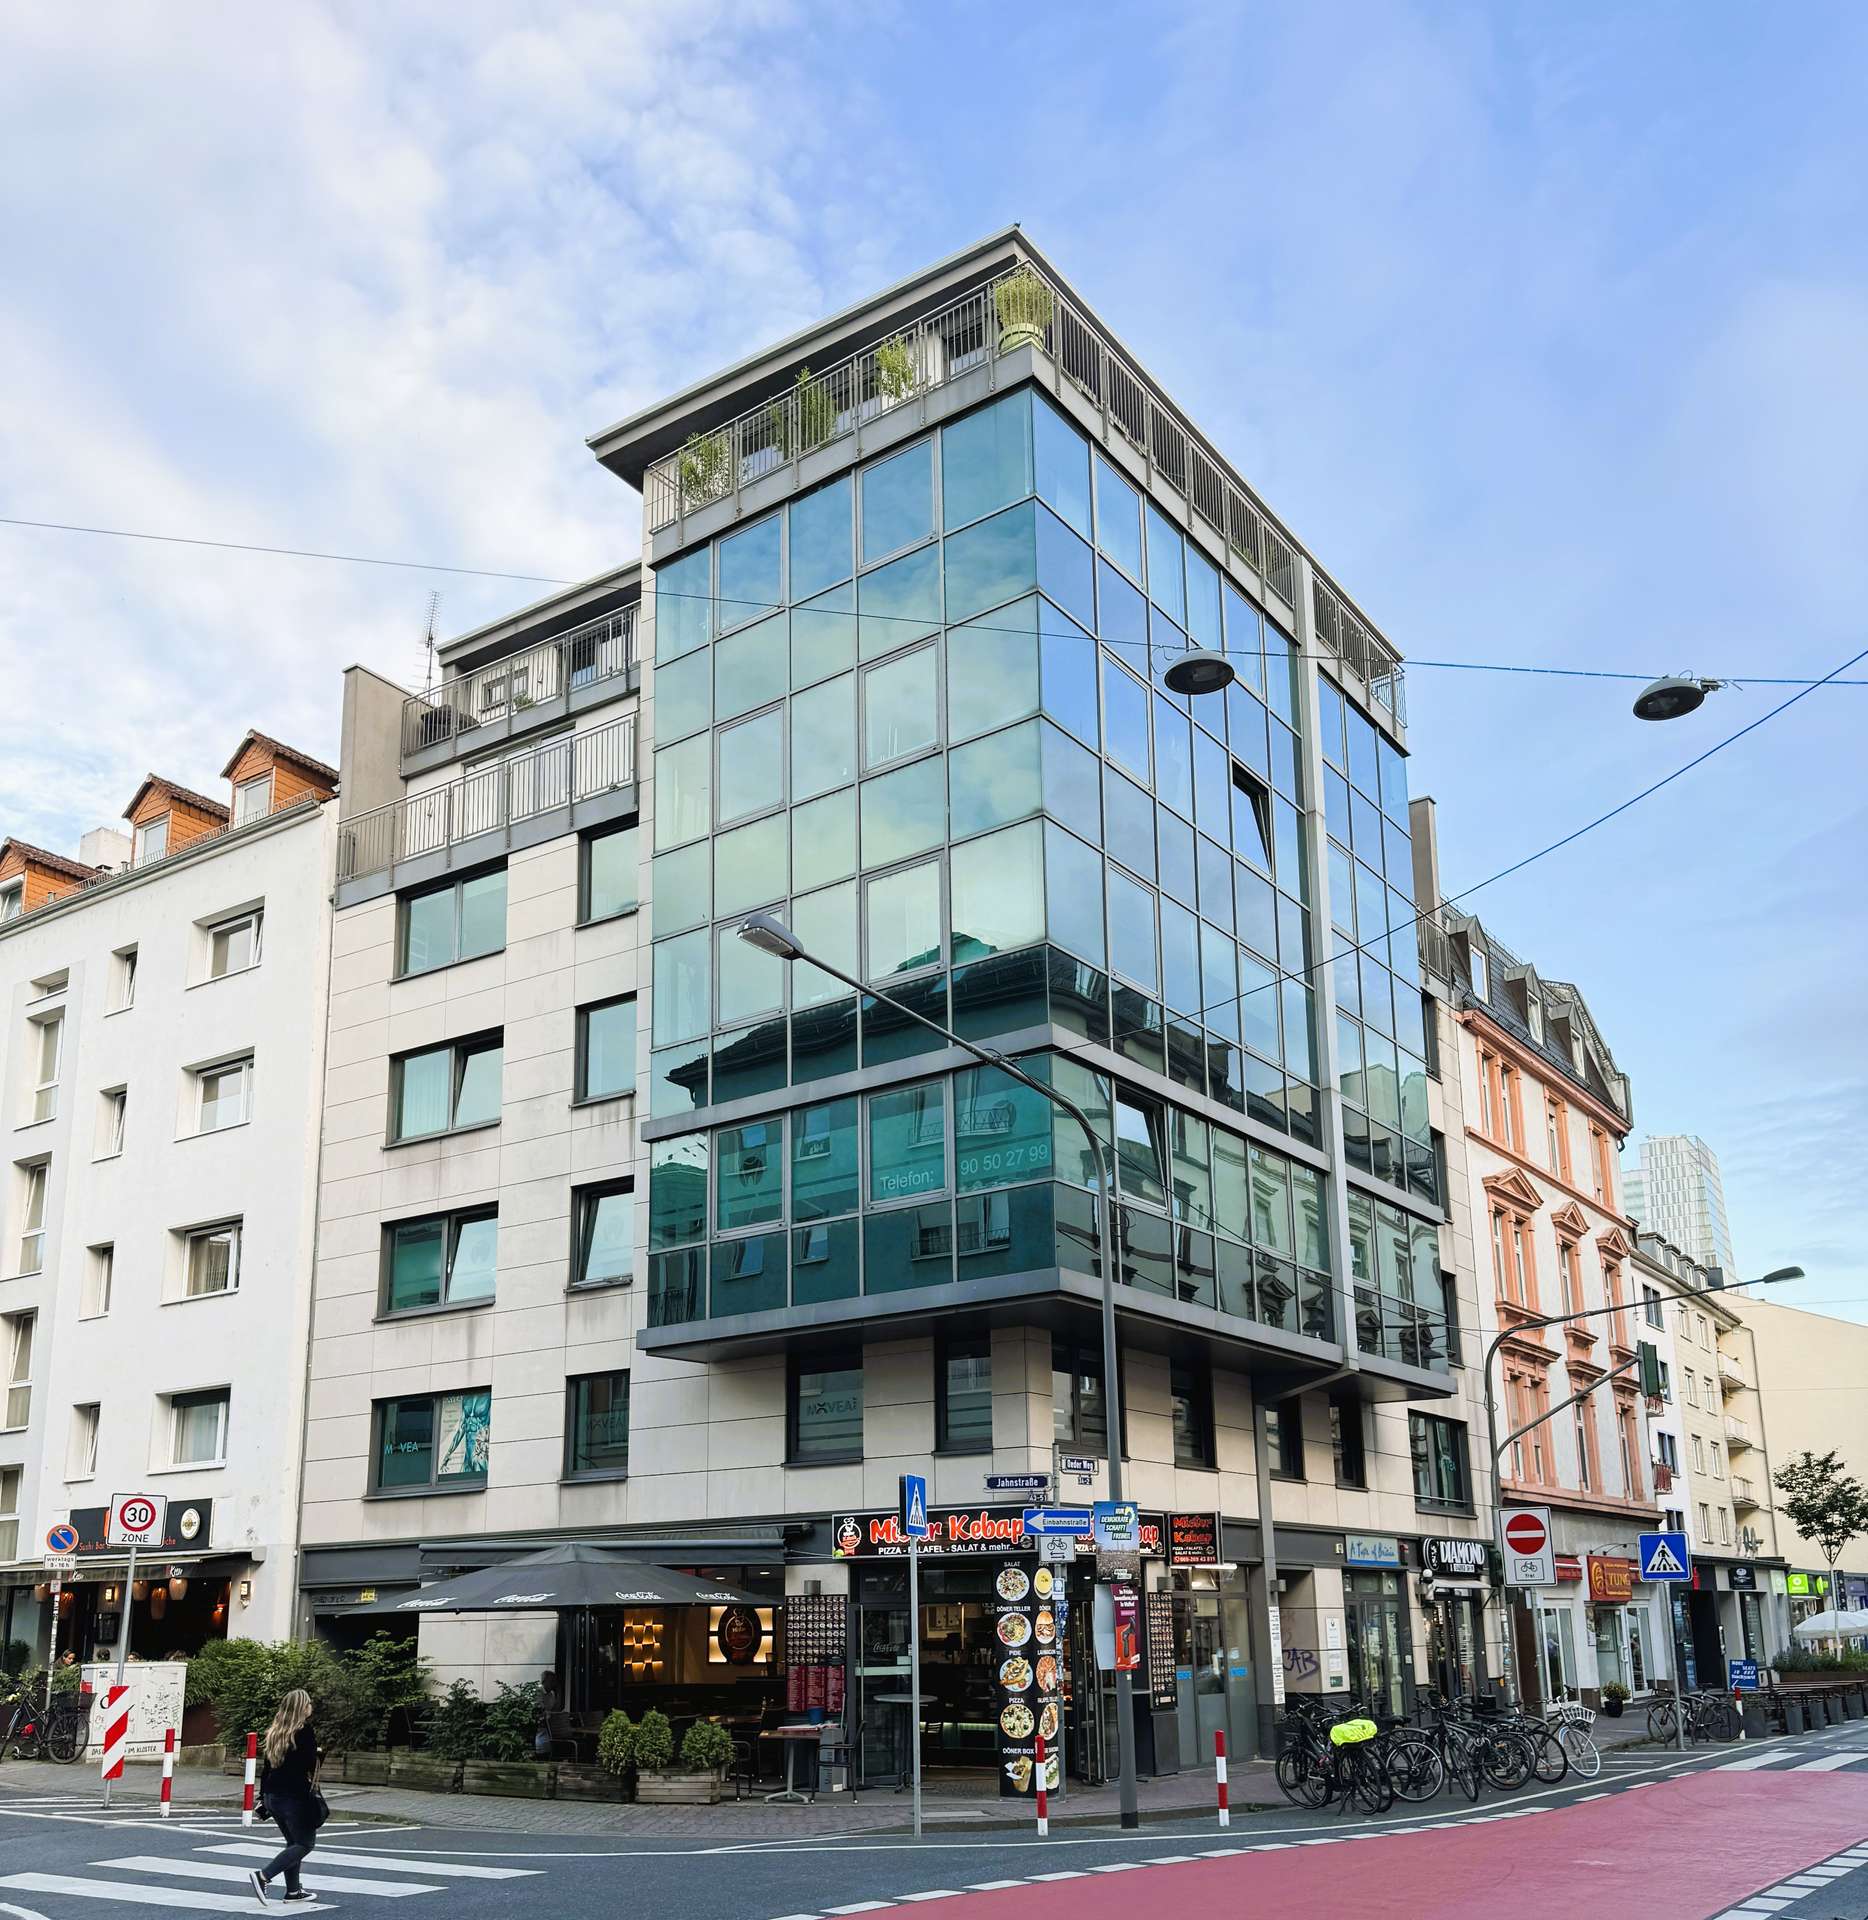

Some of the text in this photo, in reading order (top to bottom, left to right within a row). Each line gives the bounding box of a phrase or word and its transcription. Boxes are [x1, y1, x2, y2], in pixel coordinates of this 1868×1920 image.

[879, 1143, 1048, 1191] Telefon: 90 50 27 99
[1084, 1459, 1094, 1471] Weg
[996, 1478, 1039, 1488] Jahnstraße
[126, 1507, 149, 1523] 30
[1173, 1515, 1213, 1528] Mister
[948, 1511, 1025, 1545] Kebap
[1042, 1518, 1087, 1526] Einbahnstraße
[121, 1533, 149, 1543] ZONE
[1173, 1530, 1213, 1545] Kebap
[878, 1546, 901, 1555] PIZZA
[951, 1544, 978, 1553] SALAT
[1440, 1541, 1485, 1565] DIAMOND
